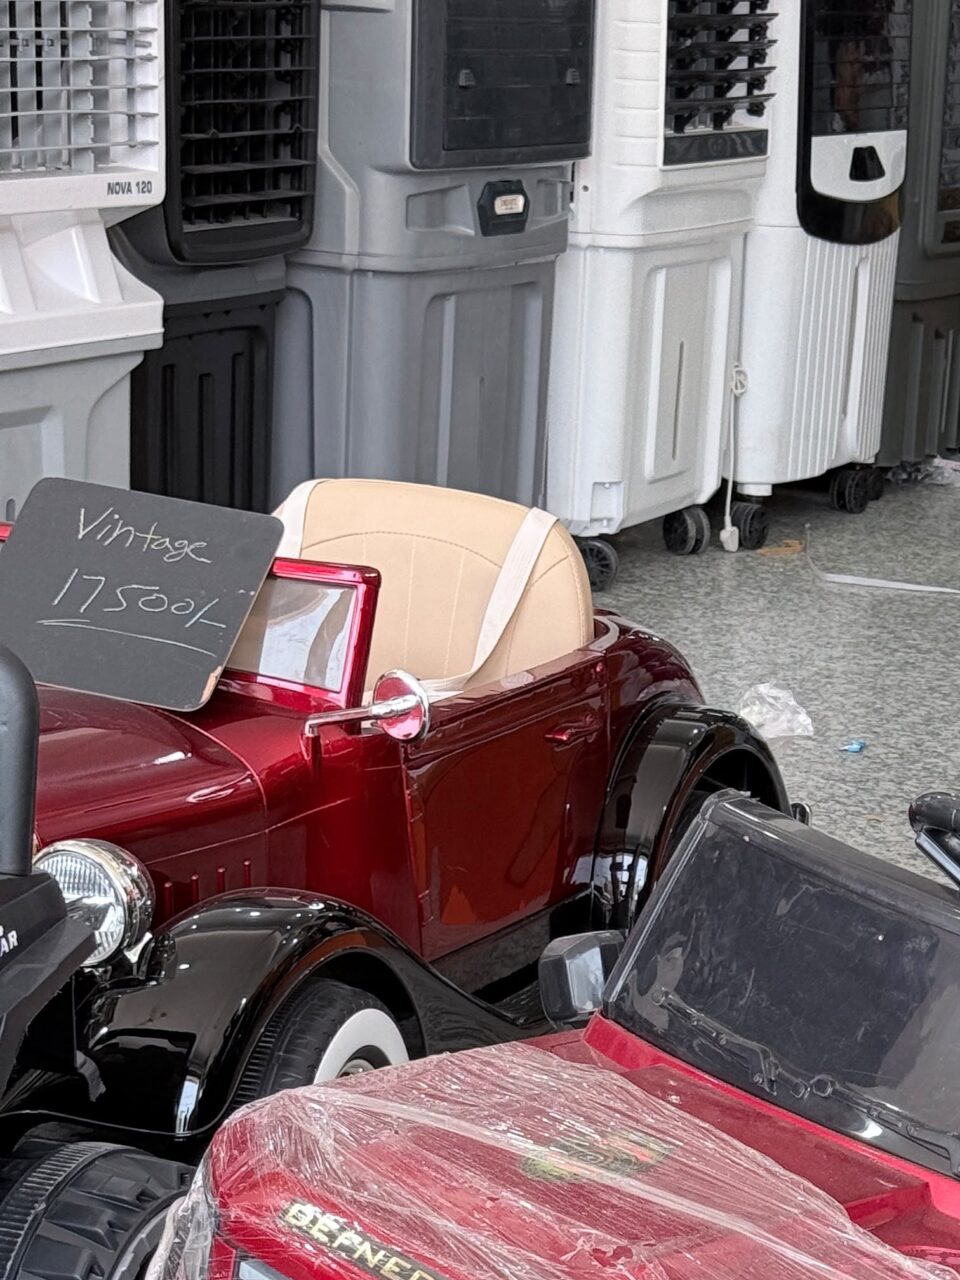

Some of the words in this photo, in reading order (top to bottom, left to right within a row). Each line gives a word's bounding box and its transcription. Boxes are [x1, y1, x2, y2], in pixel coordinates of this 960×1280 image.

[107, 181, 133, 195] NOVA
[135, 180, 152, 194] 120
[77, 506, 212, 563] Vintage
